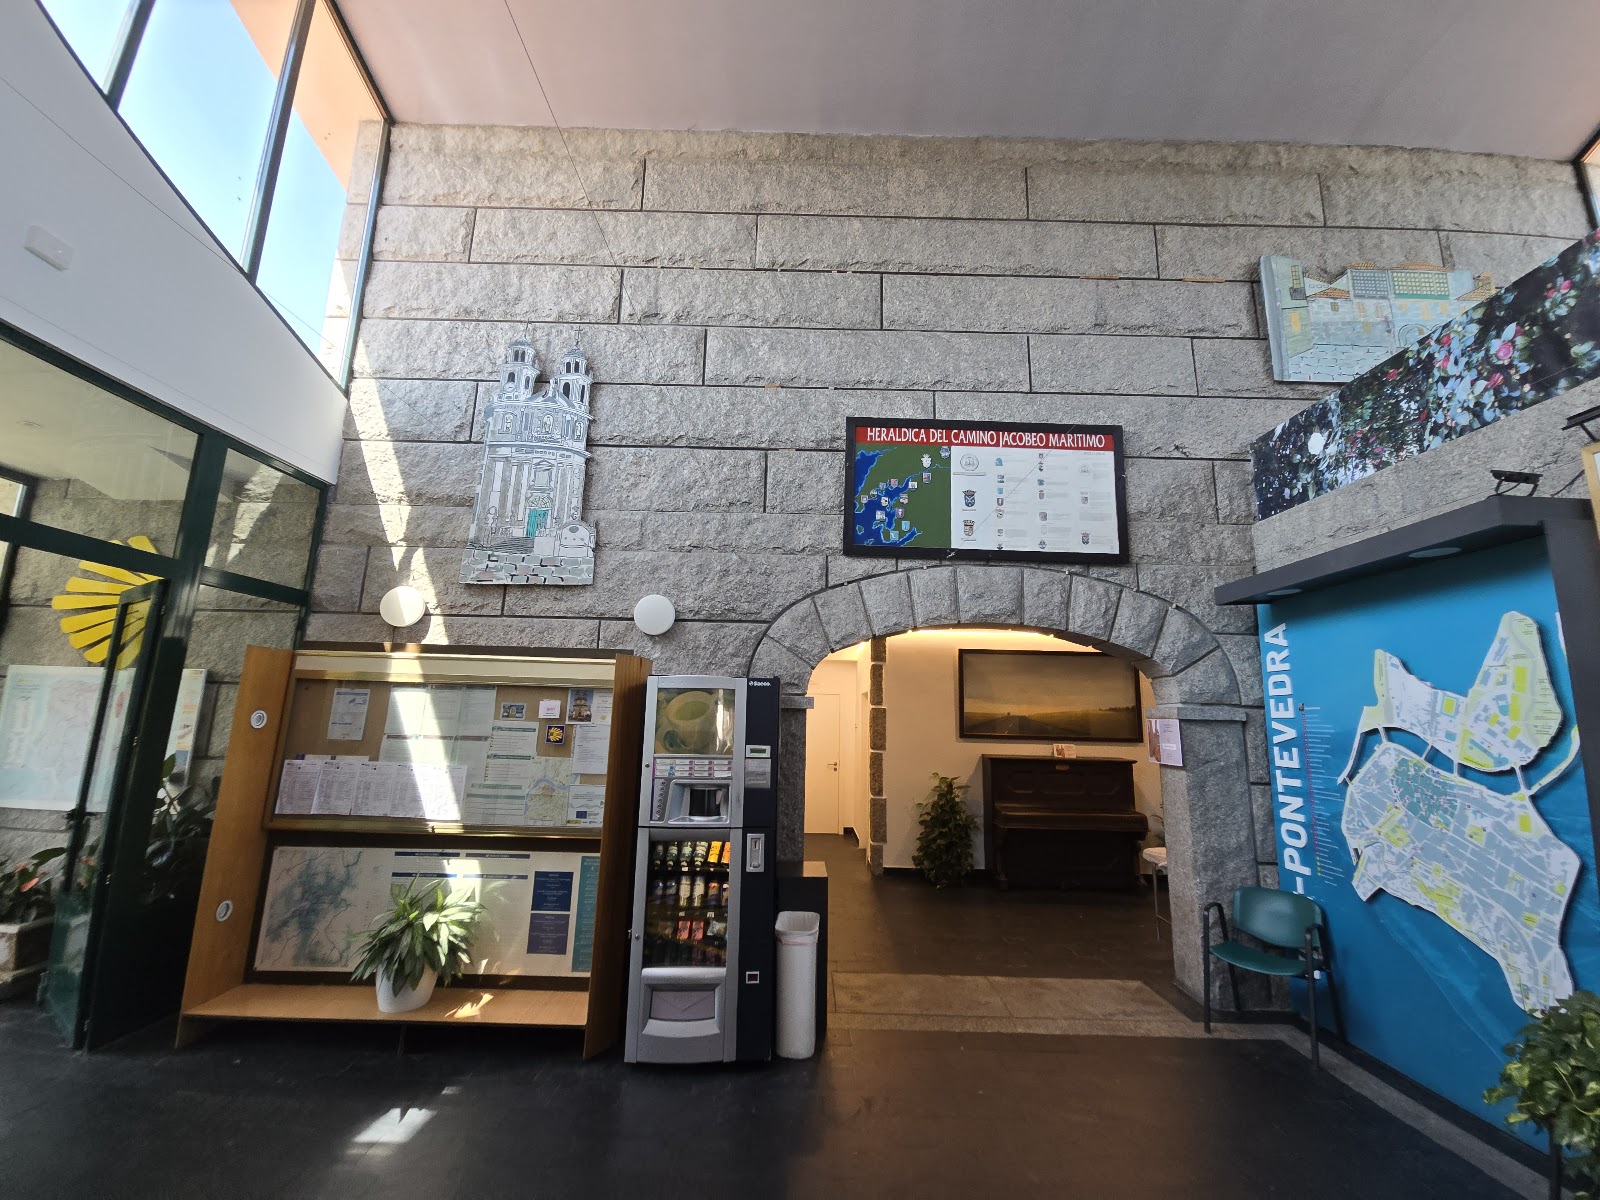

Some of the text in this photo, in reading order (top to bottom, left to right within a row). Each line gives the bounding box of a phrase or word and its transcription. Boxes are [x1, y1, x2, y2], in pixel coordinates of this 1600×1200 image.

[867, 427, 1105, 448] HERALDICA DEL CAMINO JACOBEO MARITIMO
